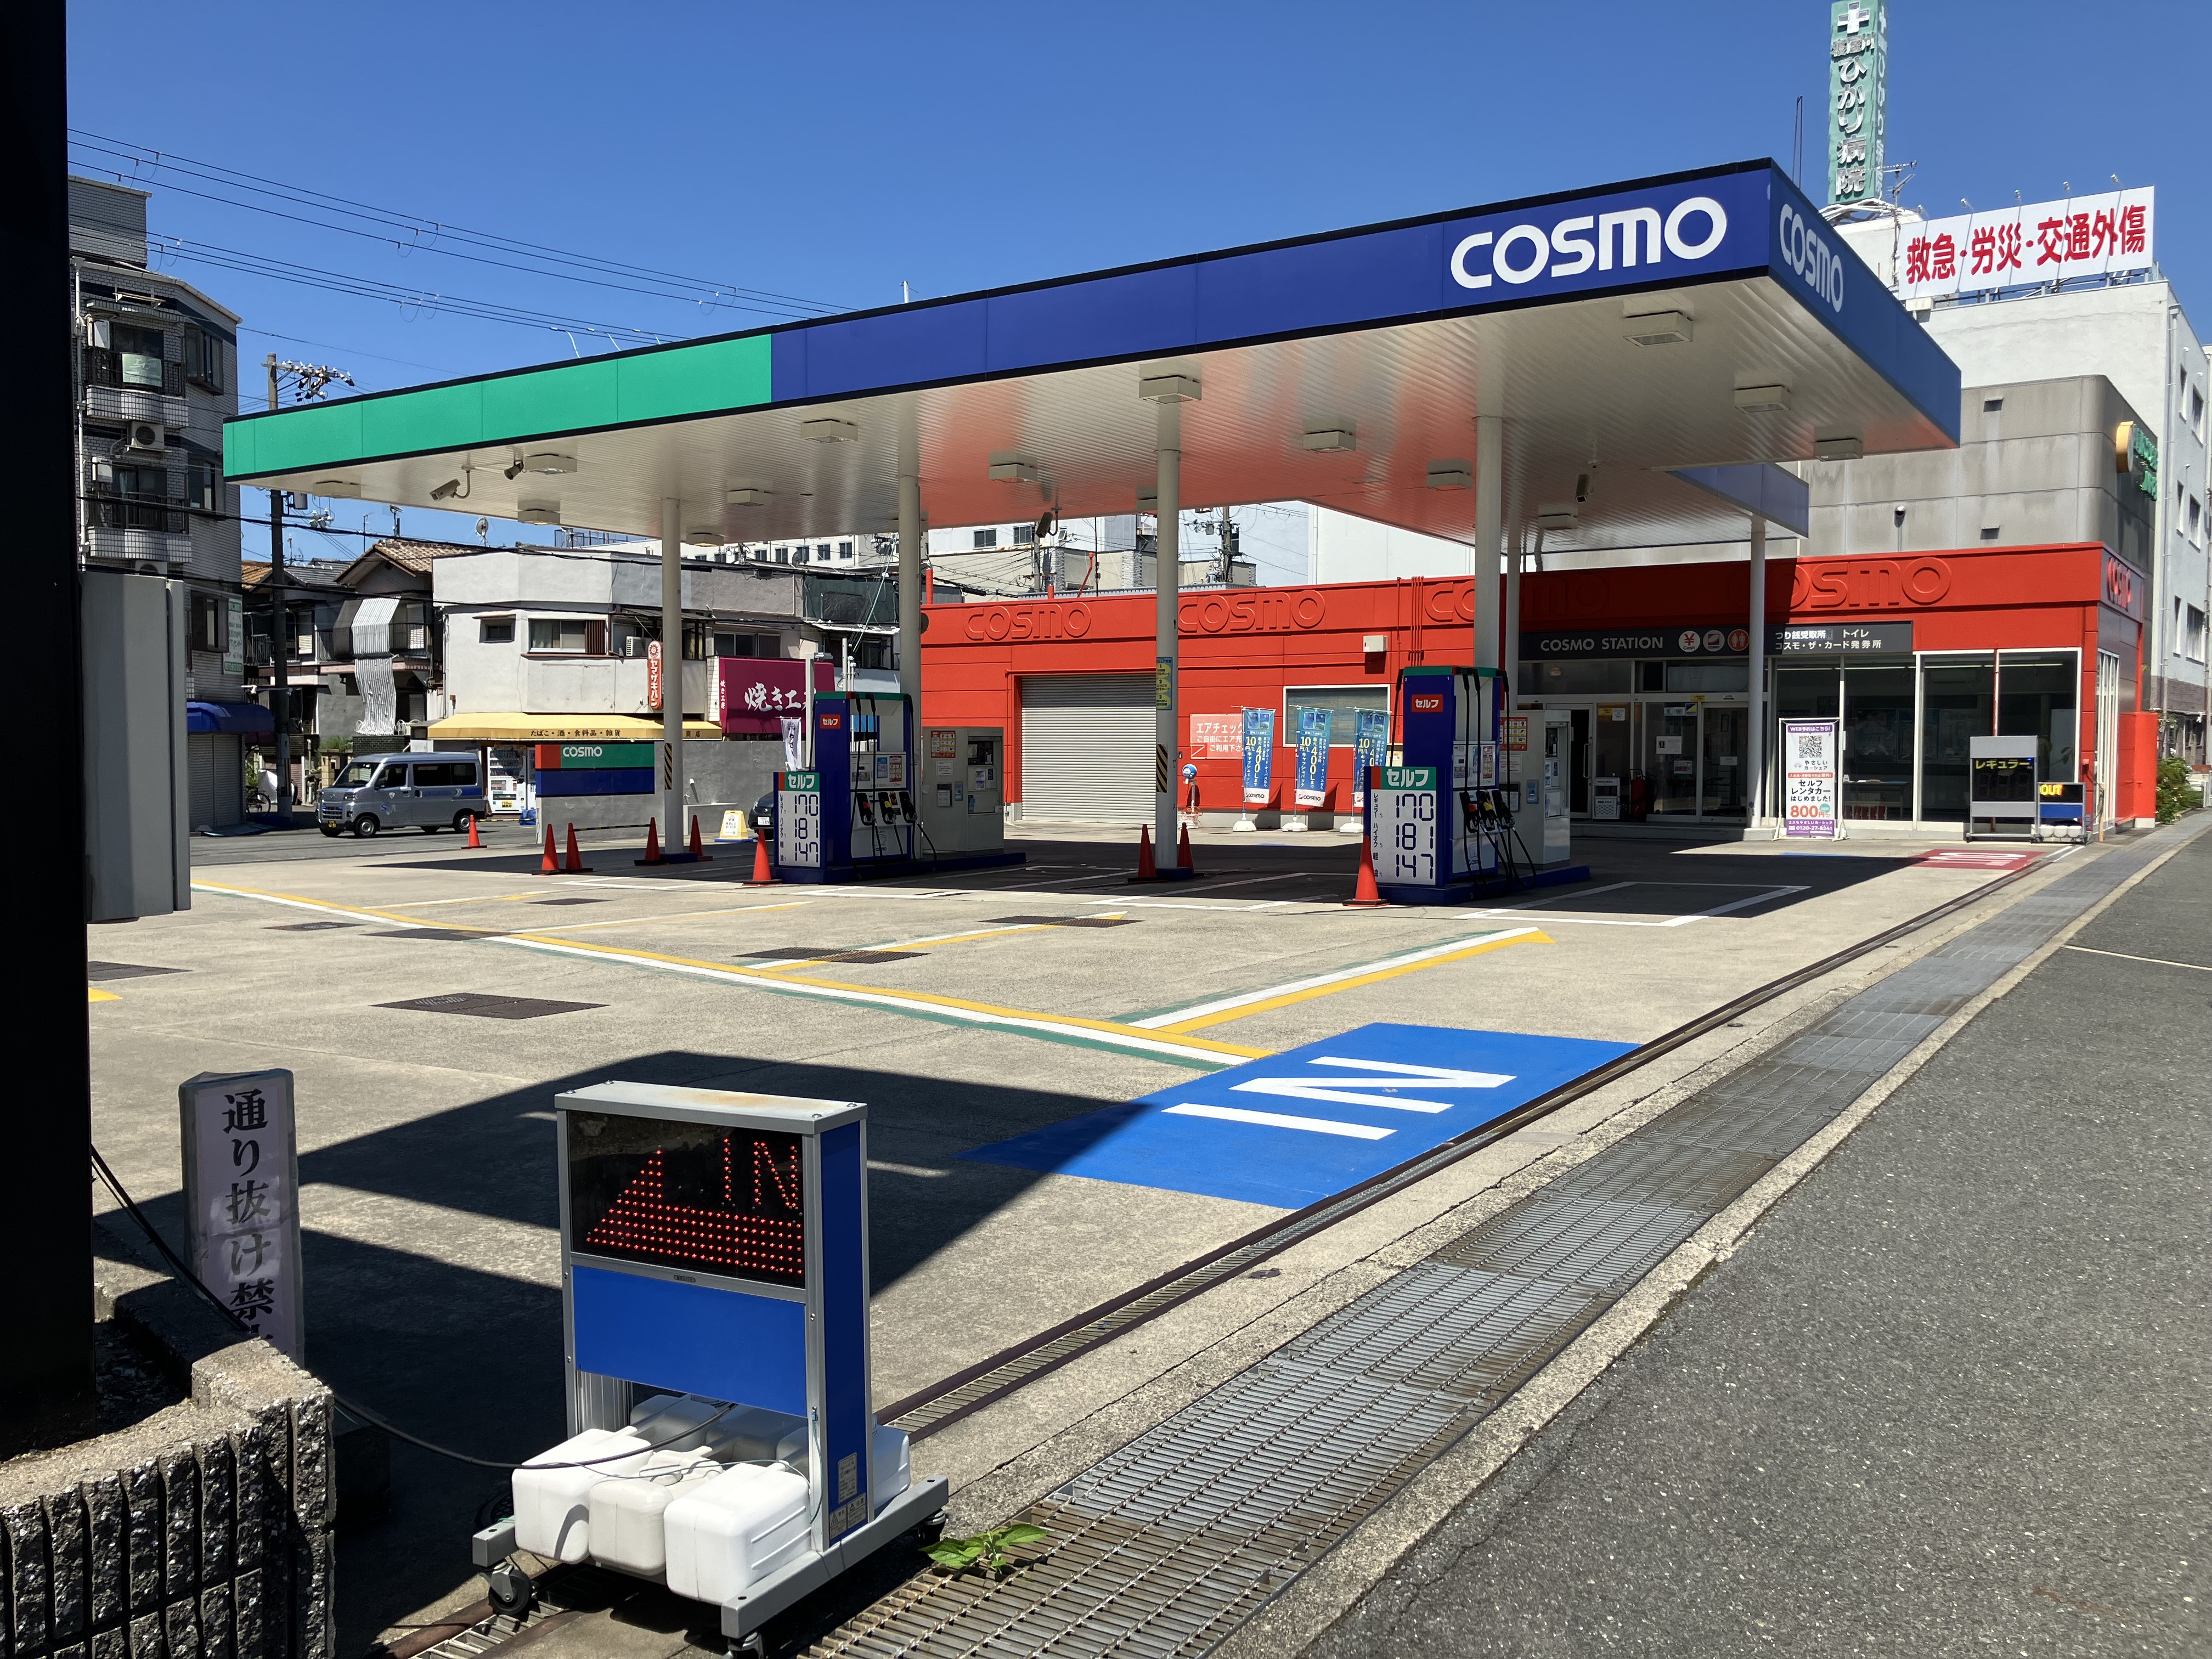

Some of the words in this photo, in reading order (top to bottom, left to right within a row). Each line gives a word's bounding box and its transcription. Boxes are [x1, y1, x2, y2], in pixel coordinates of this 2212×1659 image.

[1836, 55, 1867, 195] ひかり病院
[1451, 197, 1728, 289] COSMO
[1906, 205, 2147, 284] 救急・労災・交通外傷
[1780, 204, 1843, 313] COSMO
[963, 601, 1092, 641] COSMO
[1178, 590, 1325, 633] COSMO
[1541, 638, 1595, 651] COSMO
[1601, 637, 1663, 650] STATION
[1843, 629, 1869, 638] トイレ
[1775, 640, 1882, 650] コスモ・ザ・カード発券所
[650, 659, 658, 707] ヤマザキパン
[1415, 698, 1439, 708] セルフ
[822, 718, 838, 726] セルフ
[562, 746, 603, 757] COSMO
[1976, 759, 2030, 769] レギュラー
[788, 774, 815, 789] セルフ
[1386, 769, 1429, 787] セルフ
[2040, 784, 2064, 795] OUT
[794, 794, 819, 816] 170
[1396, 793, 1434, 821] 170
[794, 817, 819, 839] 181
[1396, 822, 1434, 850] 181
[795, 842, 819, 863] 147
[1396, 853, 1434, 880] 147
[1161, 1056, 1517, 1140] IN
[724, 1138, 798, 1207] IN
